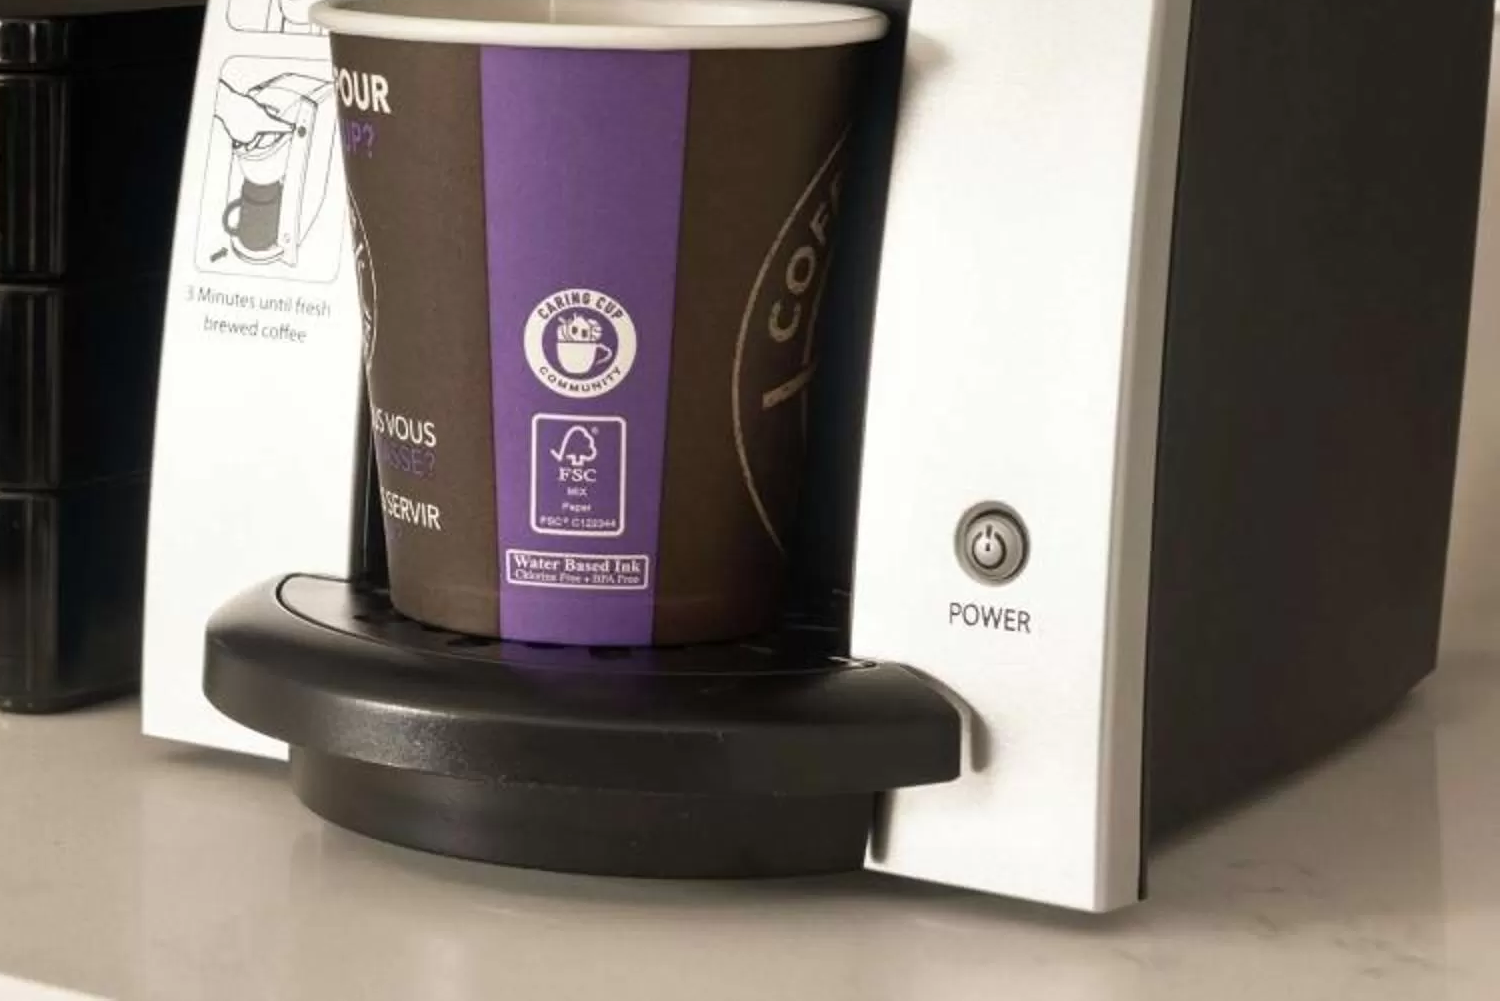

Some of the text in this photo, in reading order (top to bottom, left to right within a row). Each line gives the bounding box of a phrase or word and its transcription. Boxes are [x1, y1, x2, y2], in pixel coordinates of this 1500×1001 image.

[197, 286, 256, 310] Minutes
[259, 296, 293, 312] until
[295, 297, 332, 318] fresh
[537, 291, 624, 320] CARING CUP
[203, 315, 307, 343] brewed coffee
[540, 366, 622, 392] COMMUNITY
[385, 412, 437, 447] VOUS
[558, 468, 597, 483] FSC
[385, 490, 442, 531] SERVIR
[513, 553, 641, 573] Water Based Ink
[949, 602, 1031, 634] POWER
